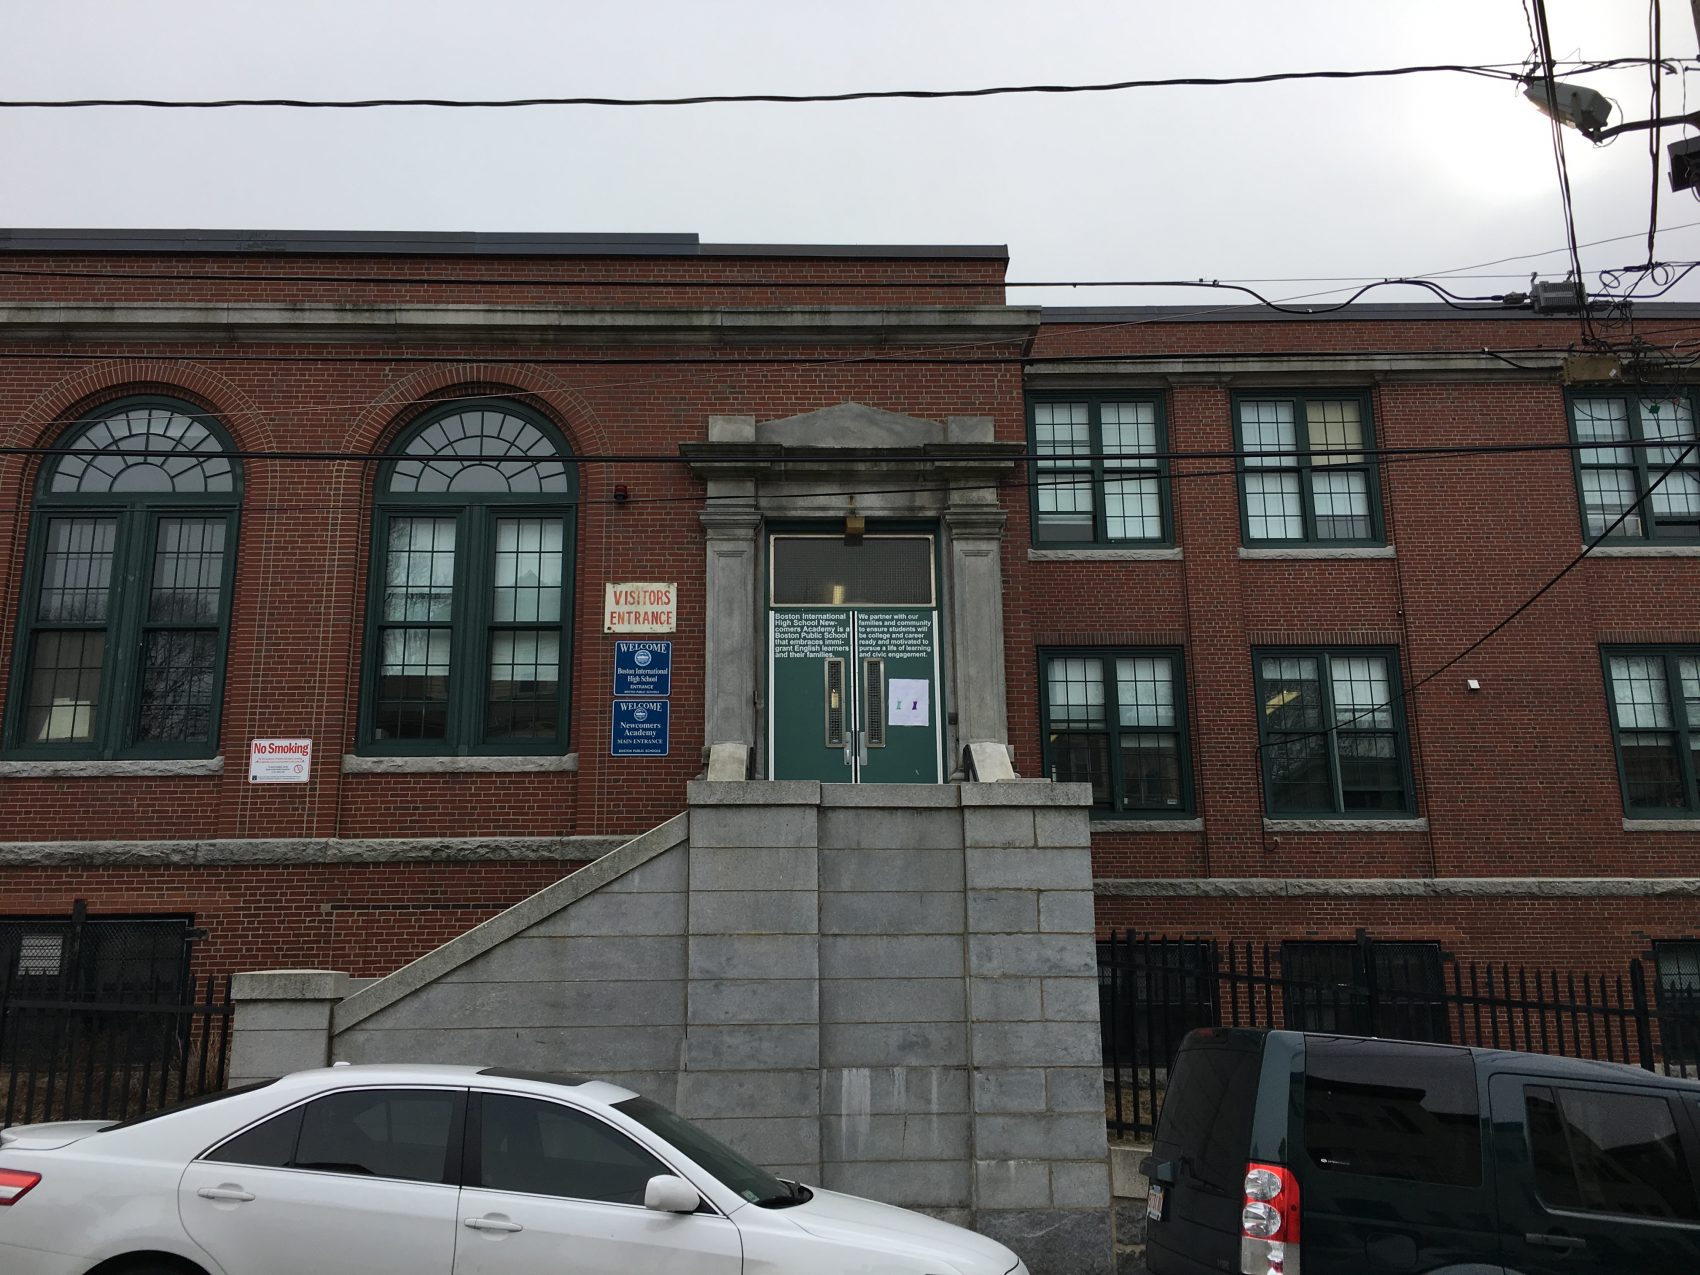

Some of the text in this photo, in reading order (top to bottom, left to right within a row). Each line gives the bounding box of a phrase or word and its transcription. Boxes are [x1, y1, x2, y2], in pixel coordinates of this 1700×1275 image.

[614, 590, 671, 605] VISITORS
[610, 611, 672, 625] ENTRANCE
[620, 644, 666, 653] WELCOME
[620, 703, 662, 711] WELCOME
[254, 743, 309, 756] No Smoking
